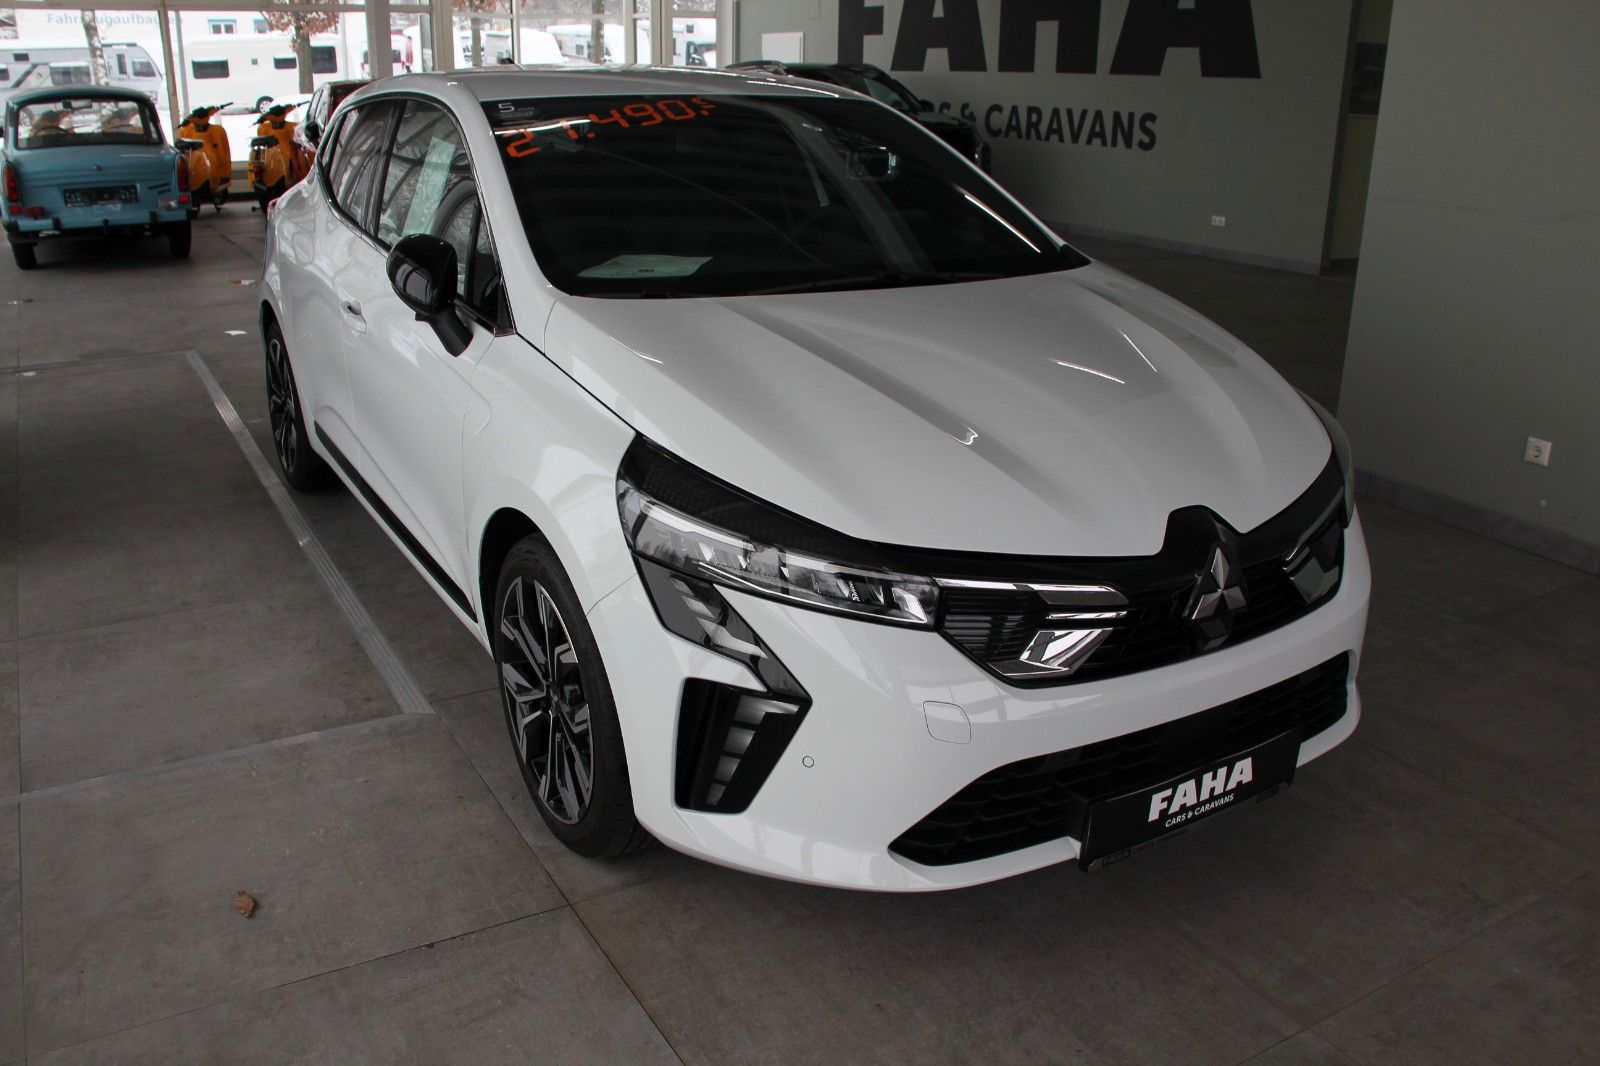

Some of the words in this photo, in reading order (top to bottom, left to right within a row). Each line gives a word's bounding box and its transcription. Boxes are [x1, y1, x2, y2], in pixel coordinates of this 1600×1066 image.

[497, 102, 516, 113] 5
[984, 103, 1158, 151] CARAVANS
[1148, 757, 1253, 822] FAHA
[1165, 812, 1186, 828] CARS
[1194, 793, 1234, 815] CARAVANS
